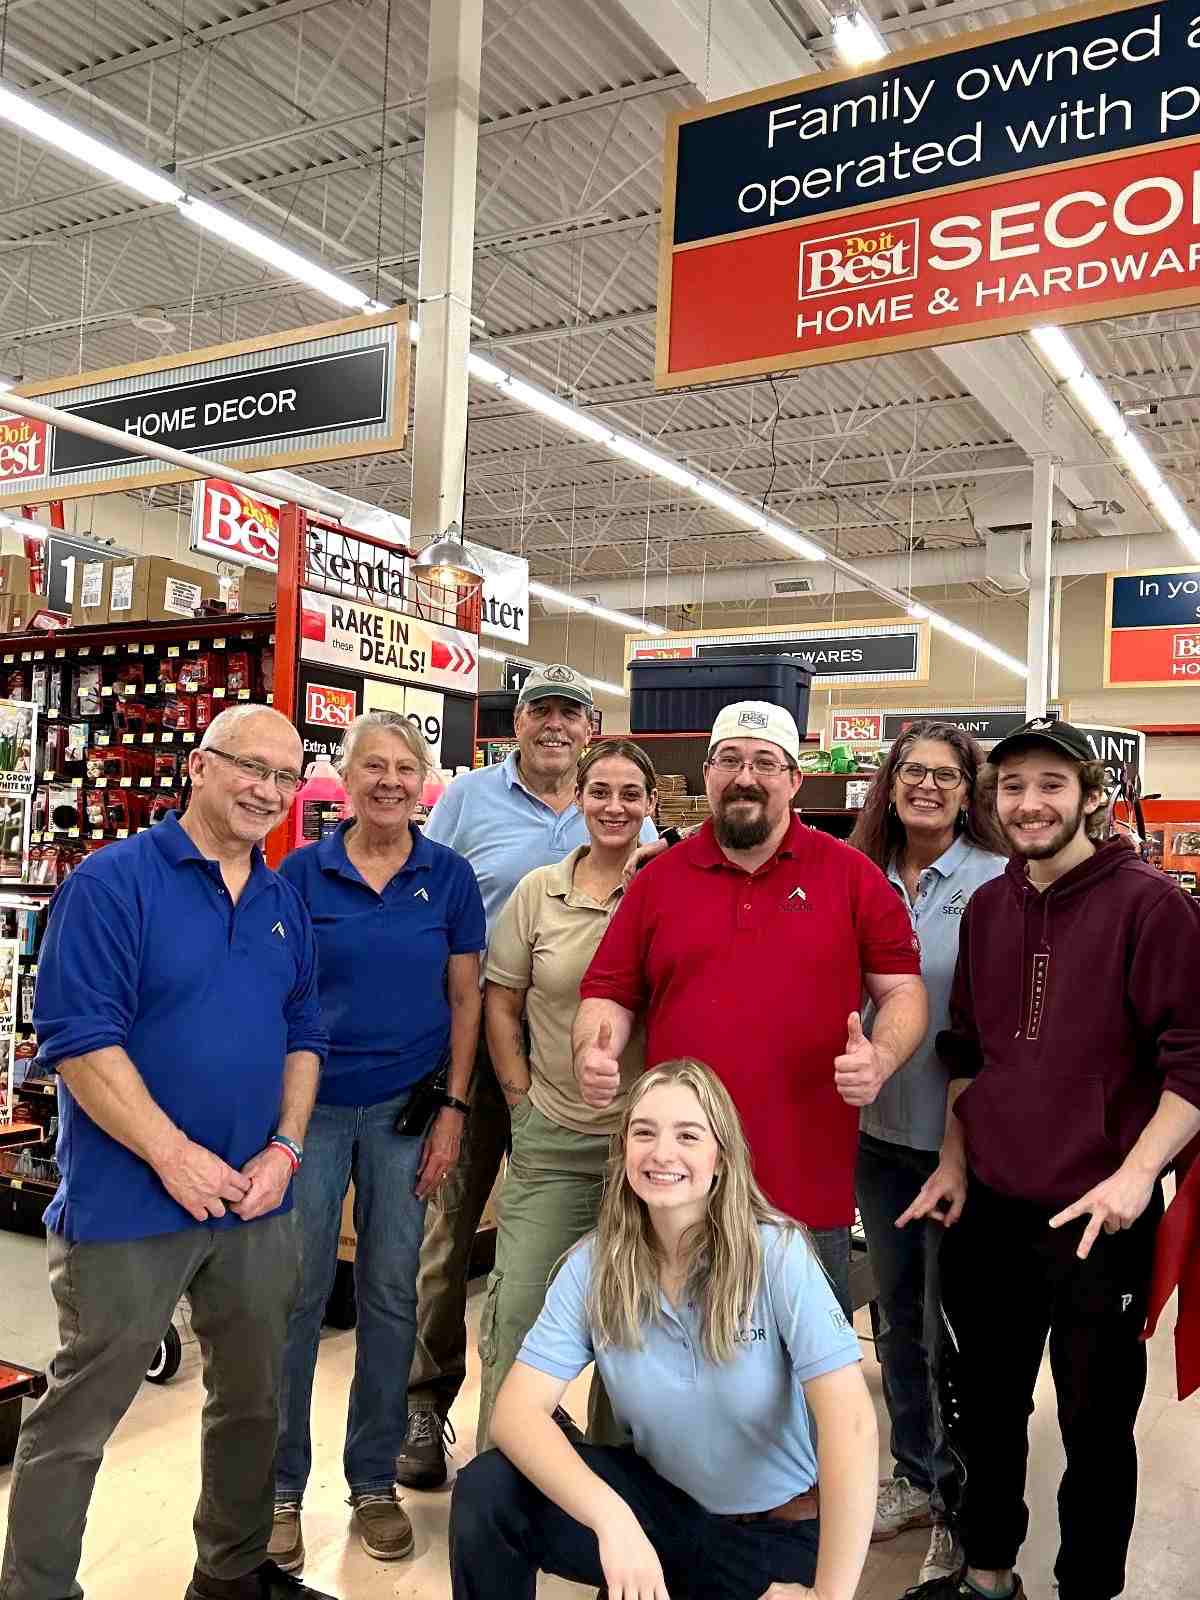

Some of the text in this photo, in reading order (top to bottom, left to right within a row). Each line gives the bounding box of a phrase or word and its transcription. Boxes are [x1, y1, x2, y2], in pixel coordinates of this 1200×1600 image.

[767, 78, 936, 149] Family
[955, 13, 1161, 101] owned
[737, 121, 982, 217] operated
[1005, 92, 1132, 154] with
[927, 169, 1200, 271] SECO
[844, 231, 895, 257] Do it
[806, 240, 911, 293] Best
[796, 294, 914, 339] HOME
[926, 286, 959, 315] &
[124, 389, 297, 438] HOME DECOR
[1140, 580, 1200, 599] In yo
[331, 604, 409, 645] RAKE IN
[332, 638, 426, 674] these DEALS!
[310, 692, 353, 723] Best
[303, 739, 327, 754] Extra
[835, 720, 878, 740] Best
[6, 773, 32, 782] GROW
[20, 784, 32, 792] KIT
